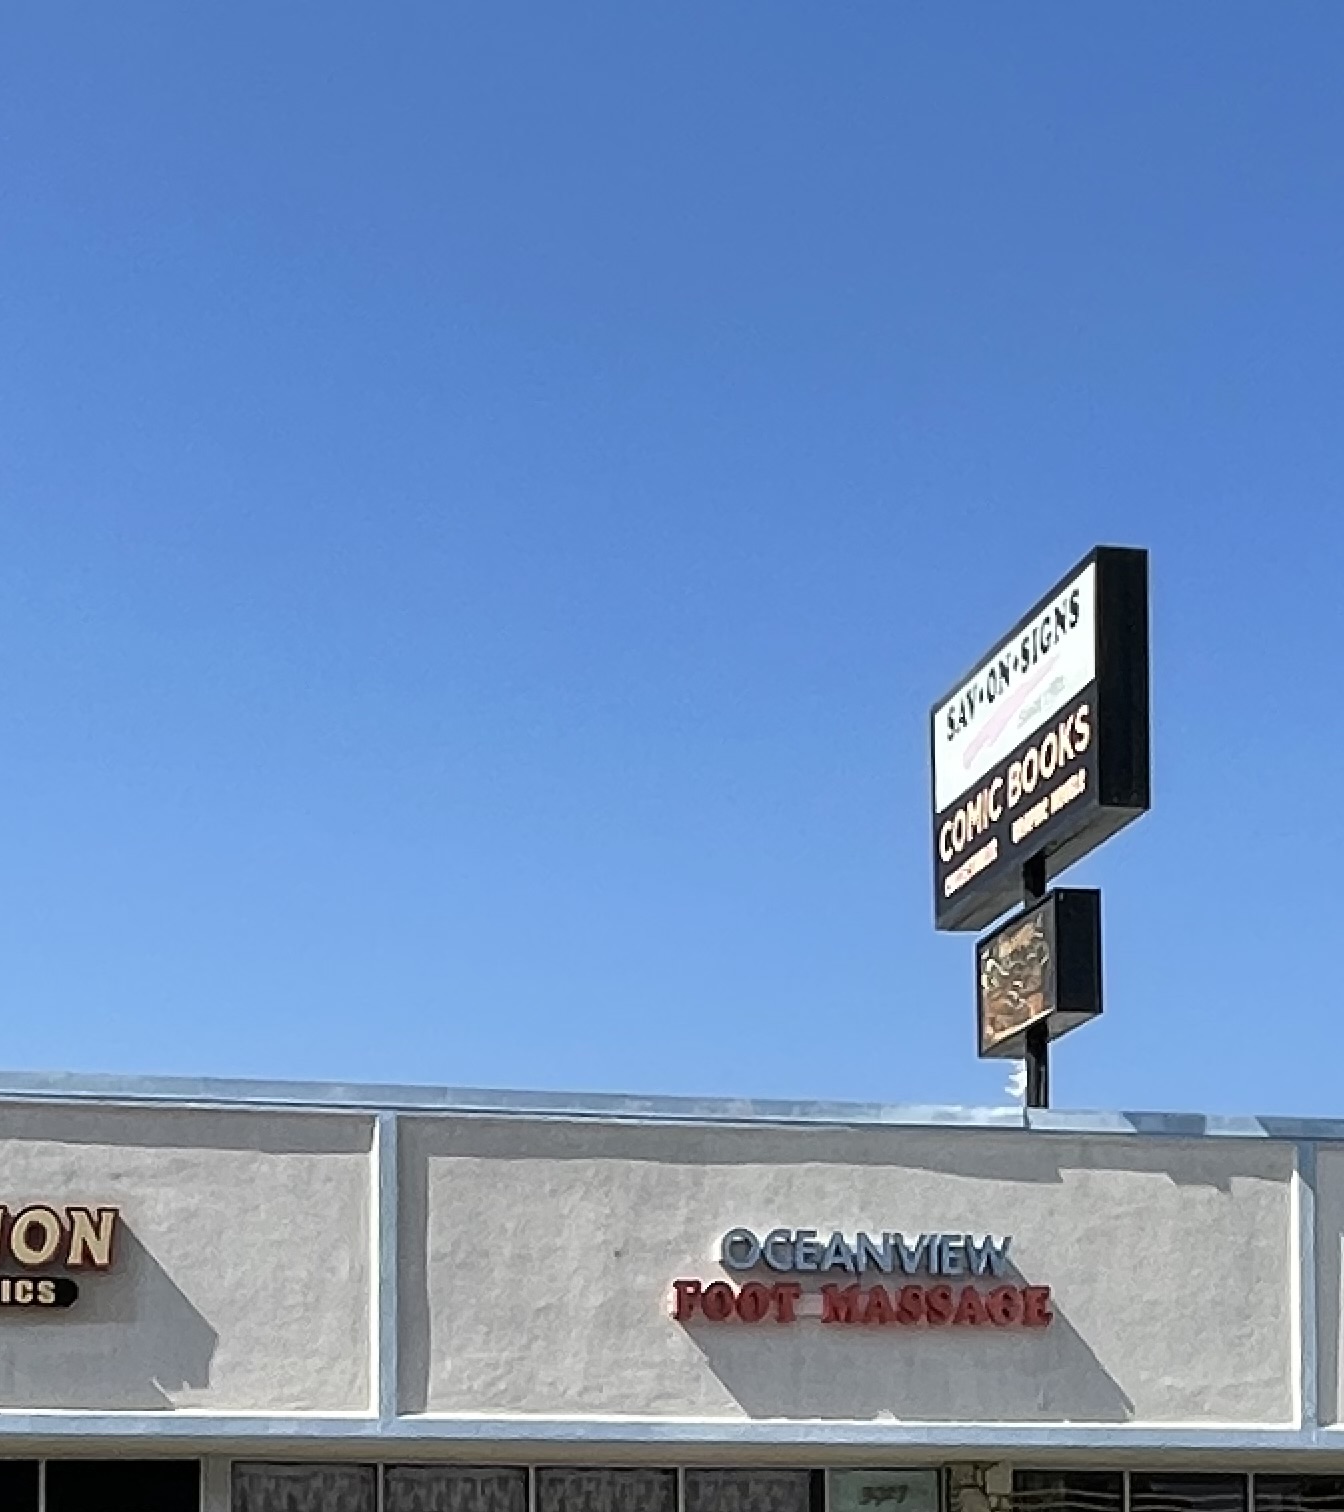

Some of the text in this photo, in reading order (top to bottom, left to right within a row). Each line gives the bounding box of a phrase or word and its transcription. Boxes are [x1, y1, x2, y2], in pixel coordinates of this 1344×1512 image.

[938, 776, 1004, 863] COMIC
[1008, 704, 1092, 809] BOOKS
[720, 1228, 1013, 1276] OCEANVIEW
[673, 1279, 1054, 1329] FOOT MASSAGE
